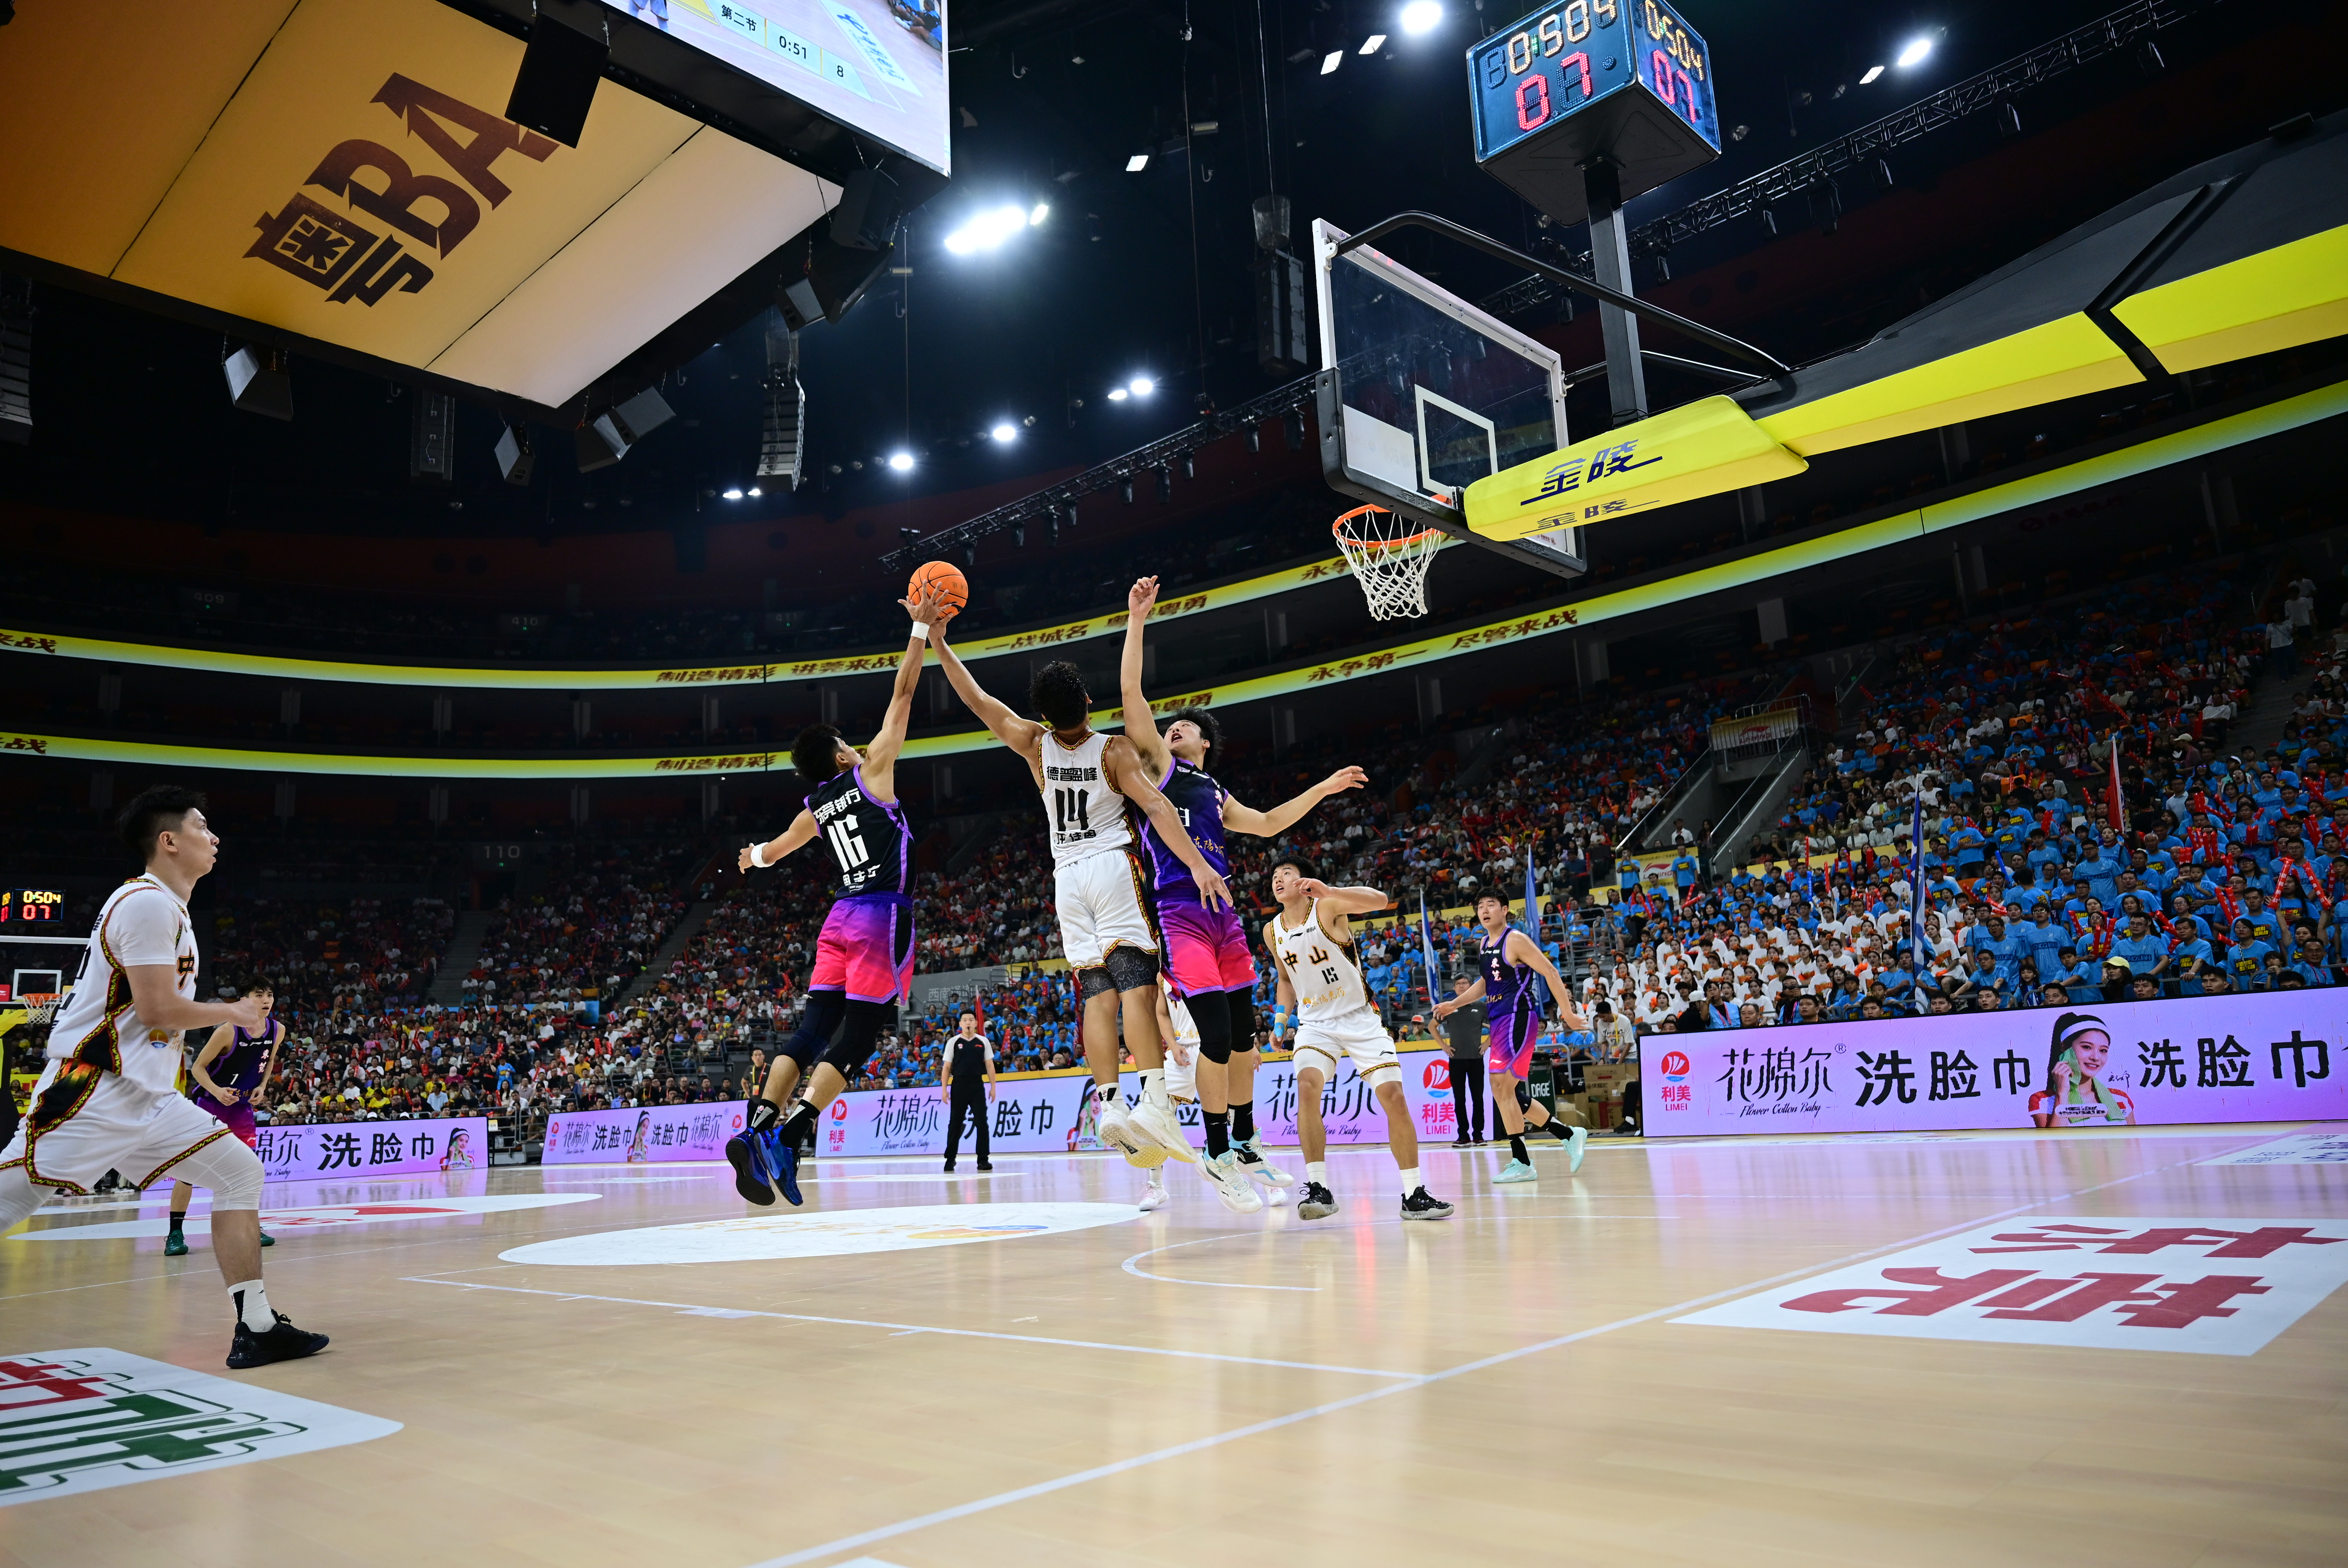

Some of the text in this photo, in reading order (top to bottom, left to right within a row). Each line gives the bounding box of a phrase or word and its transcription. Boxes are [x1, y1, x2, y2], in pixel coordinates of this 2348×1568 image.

[721, 5, 844, 78] 第二节 0:51 8
[1516, 52, 1594, 132] 07
[1520, 439, 1663, 506] 金陵
[1519, 498, 1661, 535] 金陵
[1449, 609, 1579, 651] 尽管来战
[1308, 648, 1428, 682] 永争第一
[1046, 766, 1098, 781] 德普盈峰
[813, 788, 861, 825] 东莞银行
[827, 814, 870, 873] 16
[23, 904, 50, 920] 07
[1282, 945, 1330, 975] 中山
[1321, 967, 1339, 985] 15
[2137, 1030, 2330, 1089] 洗脸巾
[1531, 1082, 1551, 1098] DAGE
[1714, 1046, 2031, 1108] 花棉尔 洗脸巾
[1661, 1085, 1692, 1102] 利美
[1665, 1103, 1688, 1111] LIMEI
[1421, 1102, 1455, 1123] 利美
[1740, 1102, 1823, 1118] Flower Cotton Baby
[592, 1124, 632, 1151] 洗脸巾
[651, 1122, 689, 1147] 洗脸巾
[829, 1129, 845, 1144] 利美
[1338, 1125, 1362, 1141] Baby
[1425, 1125, 1451, 1135] LIMEI
[317, 1132, 435, 1171] 洗脸巾
